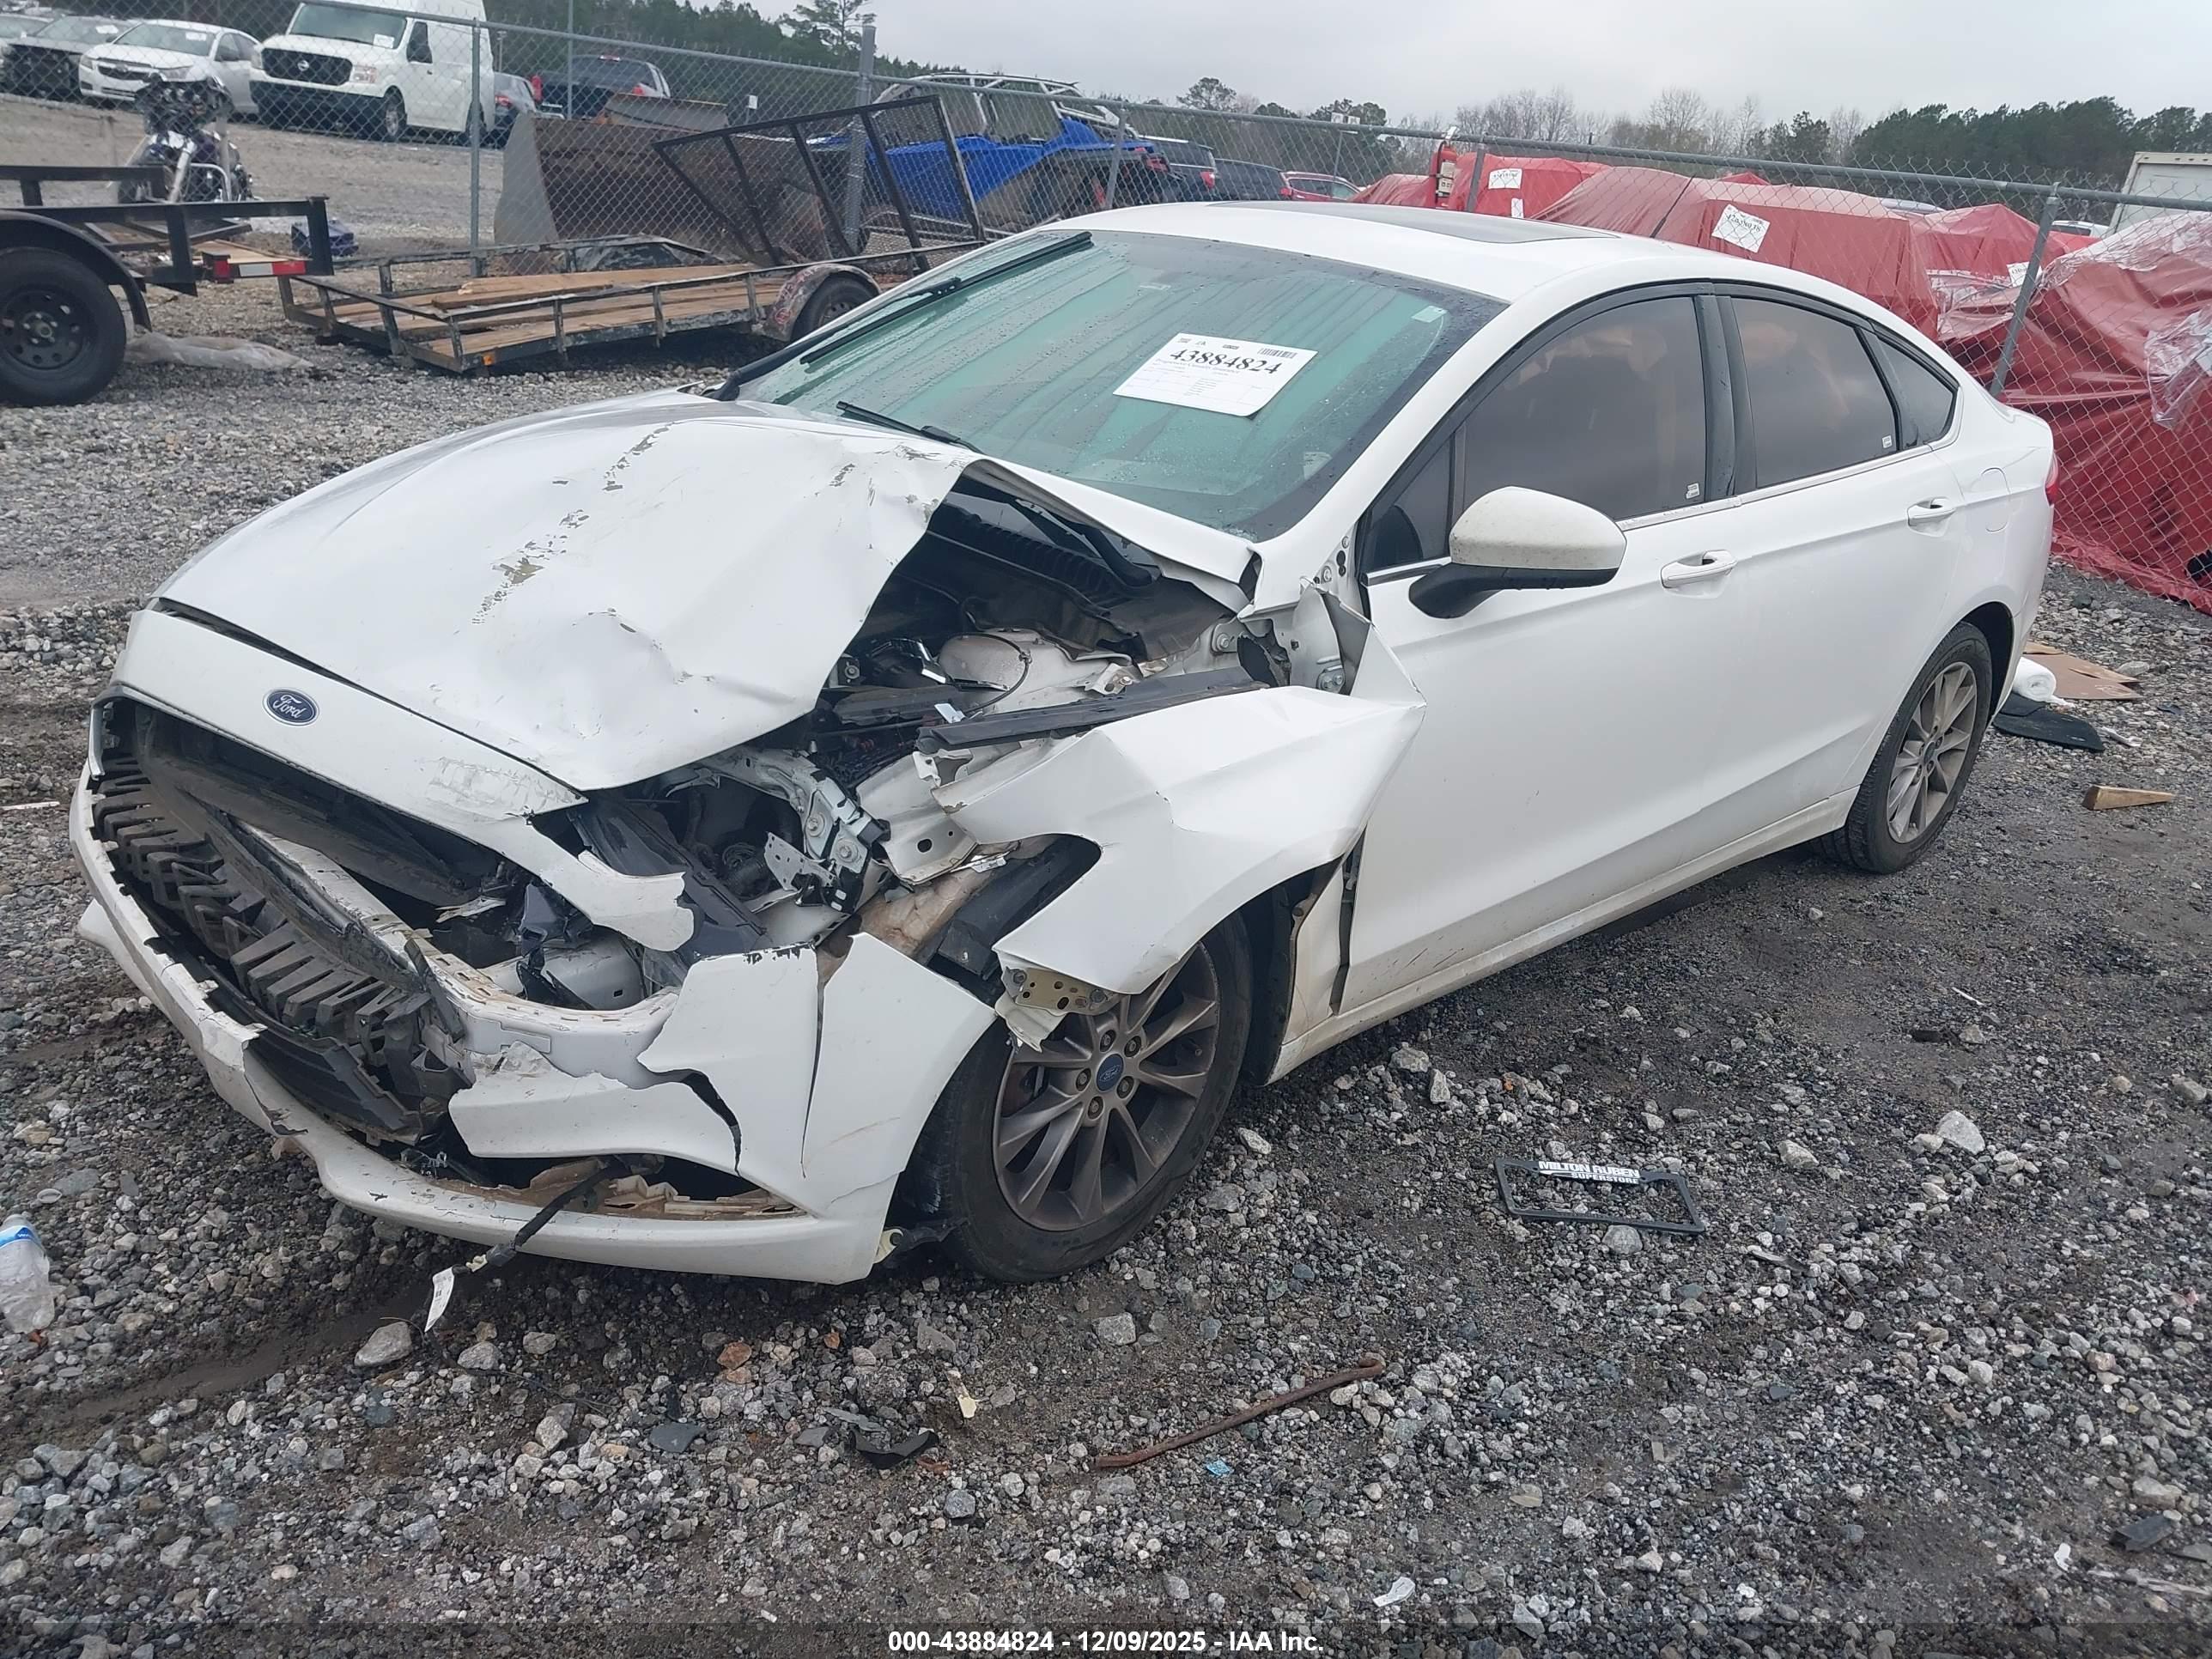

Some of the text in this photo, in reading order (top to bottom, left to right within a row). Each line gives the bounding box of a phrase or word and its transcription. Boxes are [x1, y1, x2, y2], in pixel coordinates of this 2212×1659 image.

[1170, 349, 1283, 374] 43884824
[272, 694, 307, 719] Ford
[1539, 1161, 1641, 1178] MILTON RUBEN
[1571, 1172, 1640, 1184] SUPERSTORE
